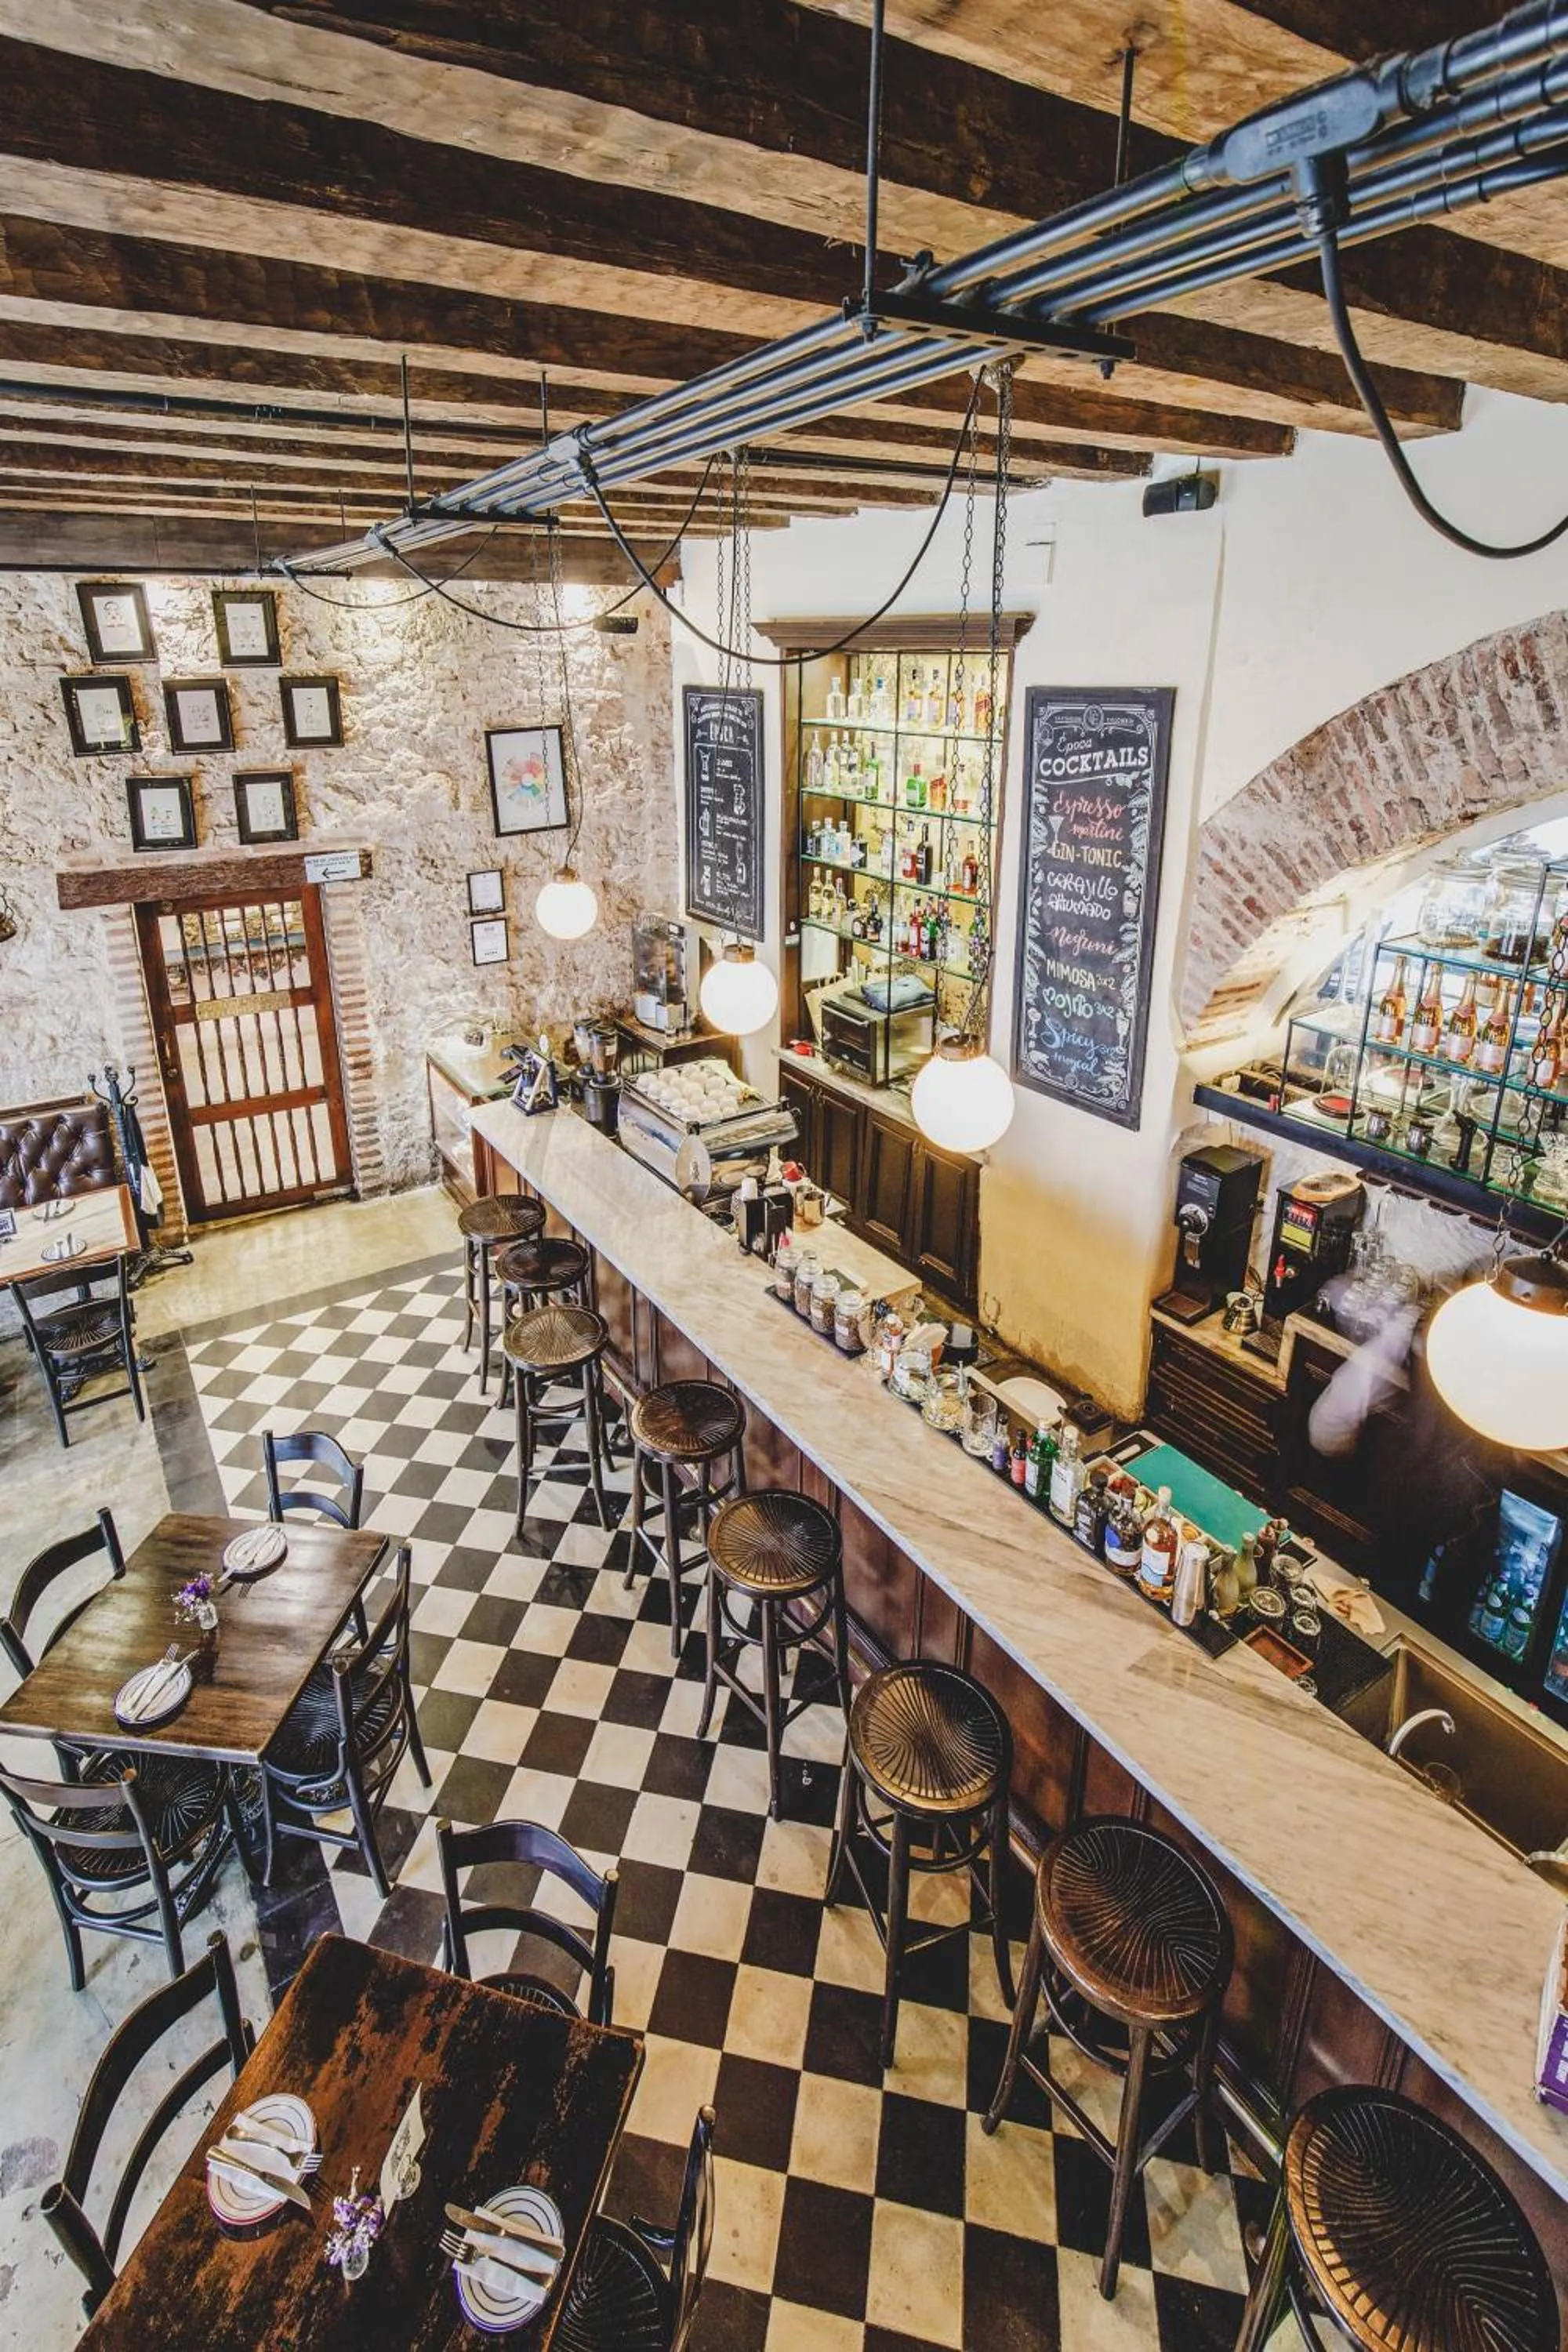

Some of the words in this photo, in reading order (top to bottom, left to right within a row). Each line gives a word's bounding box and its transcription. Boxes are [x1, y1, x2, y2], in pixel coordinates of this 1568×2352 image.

[1040, 746, 1149, 776] COCKTAILS
[1053, 789, 1123, 822] Espresso
[1050, 841, 1122, 868] GIN-TONIC
[1047, 926, 1118, 956] Negroni
[1047, 958, 1095, 991] MIMOSA
[1042, 986, 1093, 1018] MOJITO
